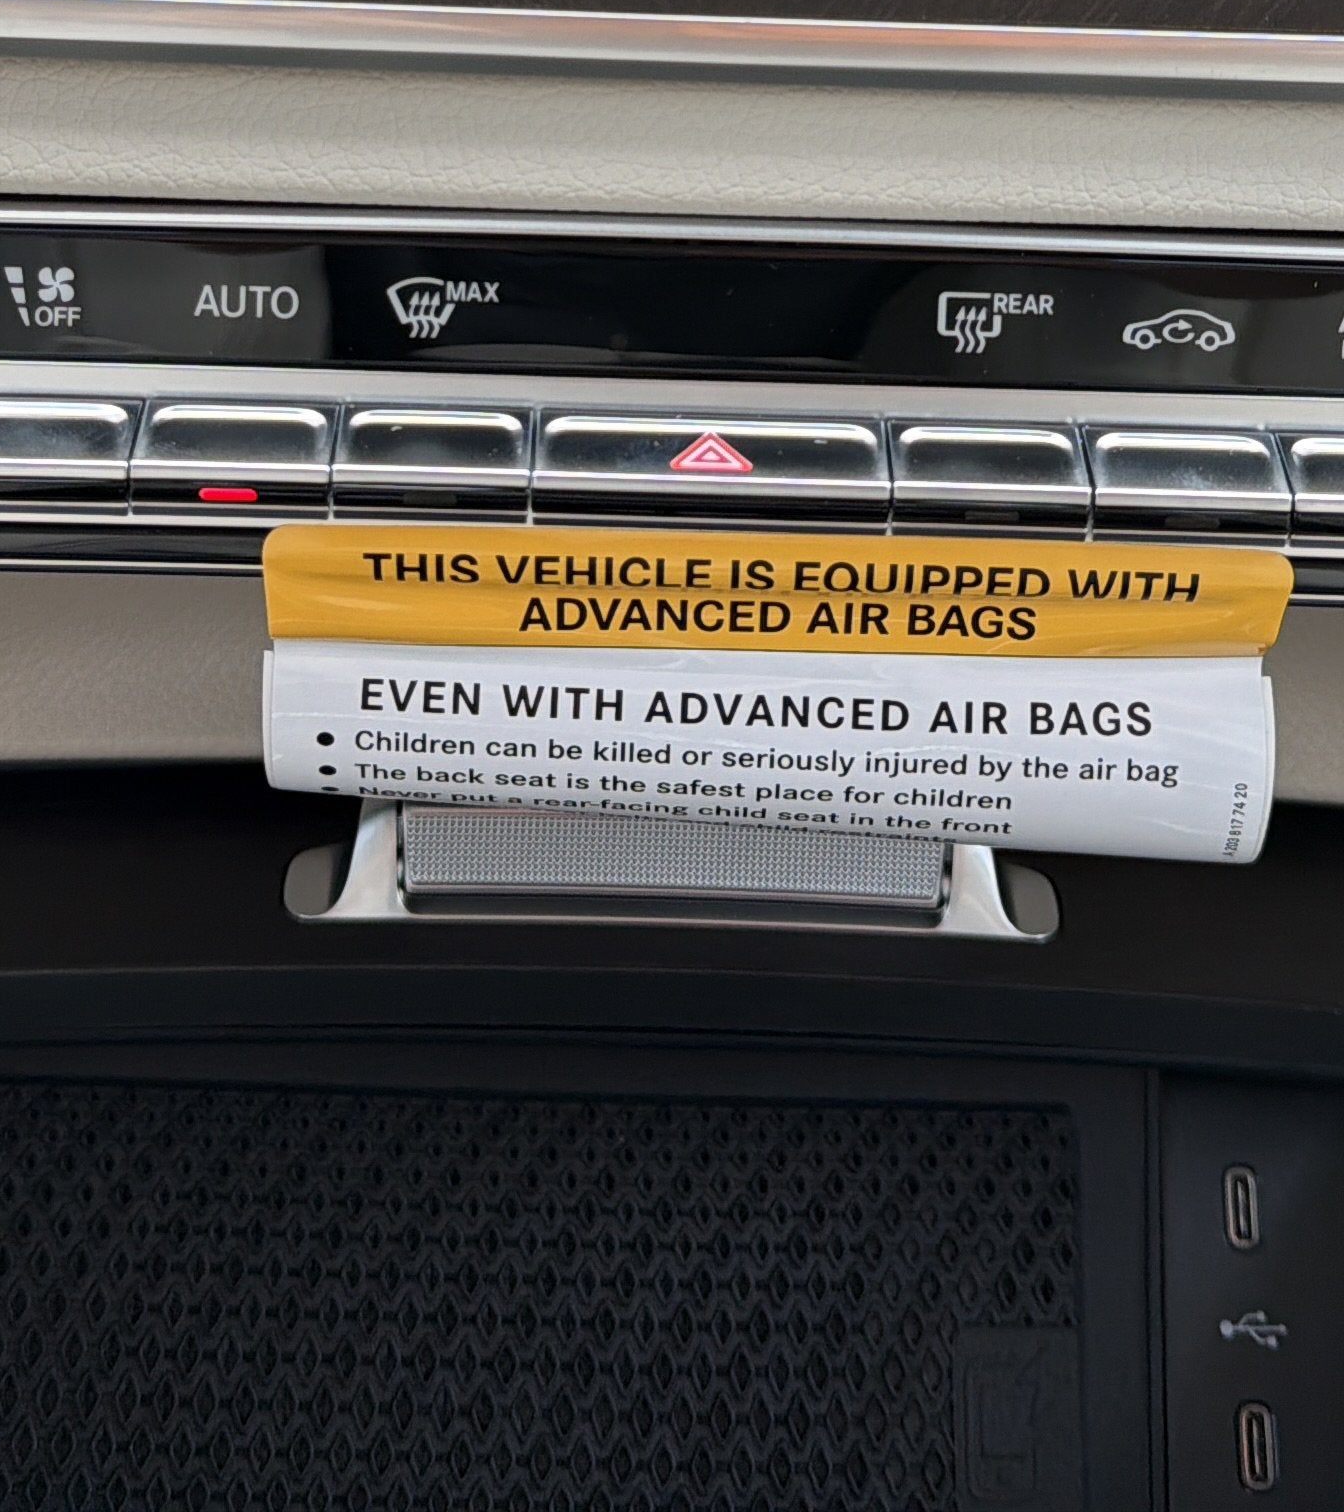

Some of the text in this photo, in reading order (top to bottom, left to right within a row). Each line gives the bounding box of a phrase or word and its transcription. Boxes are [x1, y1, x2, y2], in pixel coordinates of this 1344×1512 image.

[193, 284, 299, 320] AUTO
[446, 280, 500, 303] MAX
[993, 292, 1054, 315] REAR
[34, 305, 82, 327] OFF
[362, 552, 1200, 602] THIS VEHICLE IS EQUIPPED WITH
[519, 597, 1036, 641] ADVANCED AIR BAGS
[360, 678, 1152, 737] EVEN WITH ADVANCED AIR BAGS
[355, 730, 1179, 788] Children can be killed or seriously injured by the air bag
[354, 763, 1012, 810] The back seat is the safest place for children
[1234, 783, 1248, 798] 20
[359, 787, 1012, 835] Never put a rear-facing child seat in the front
